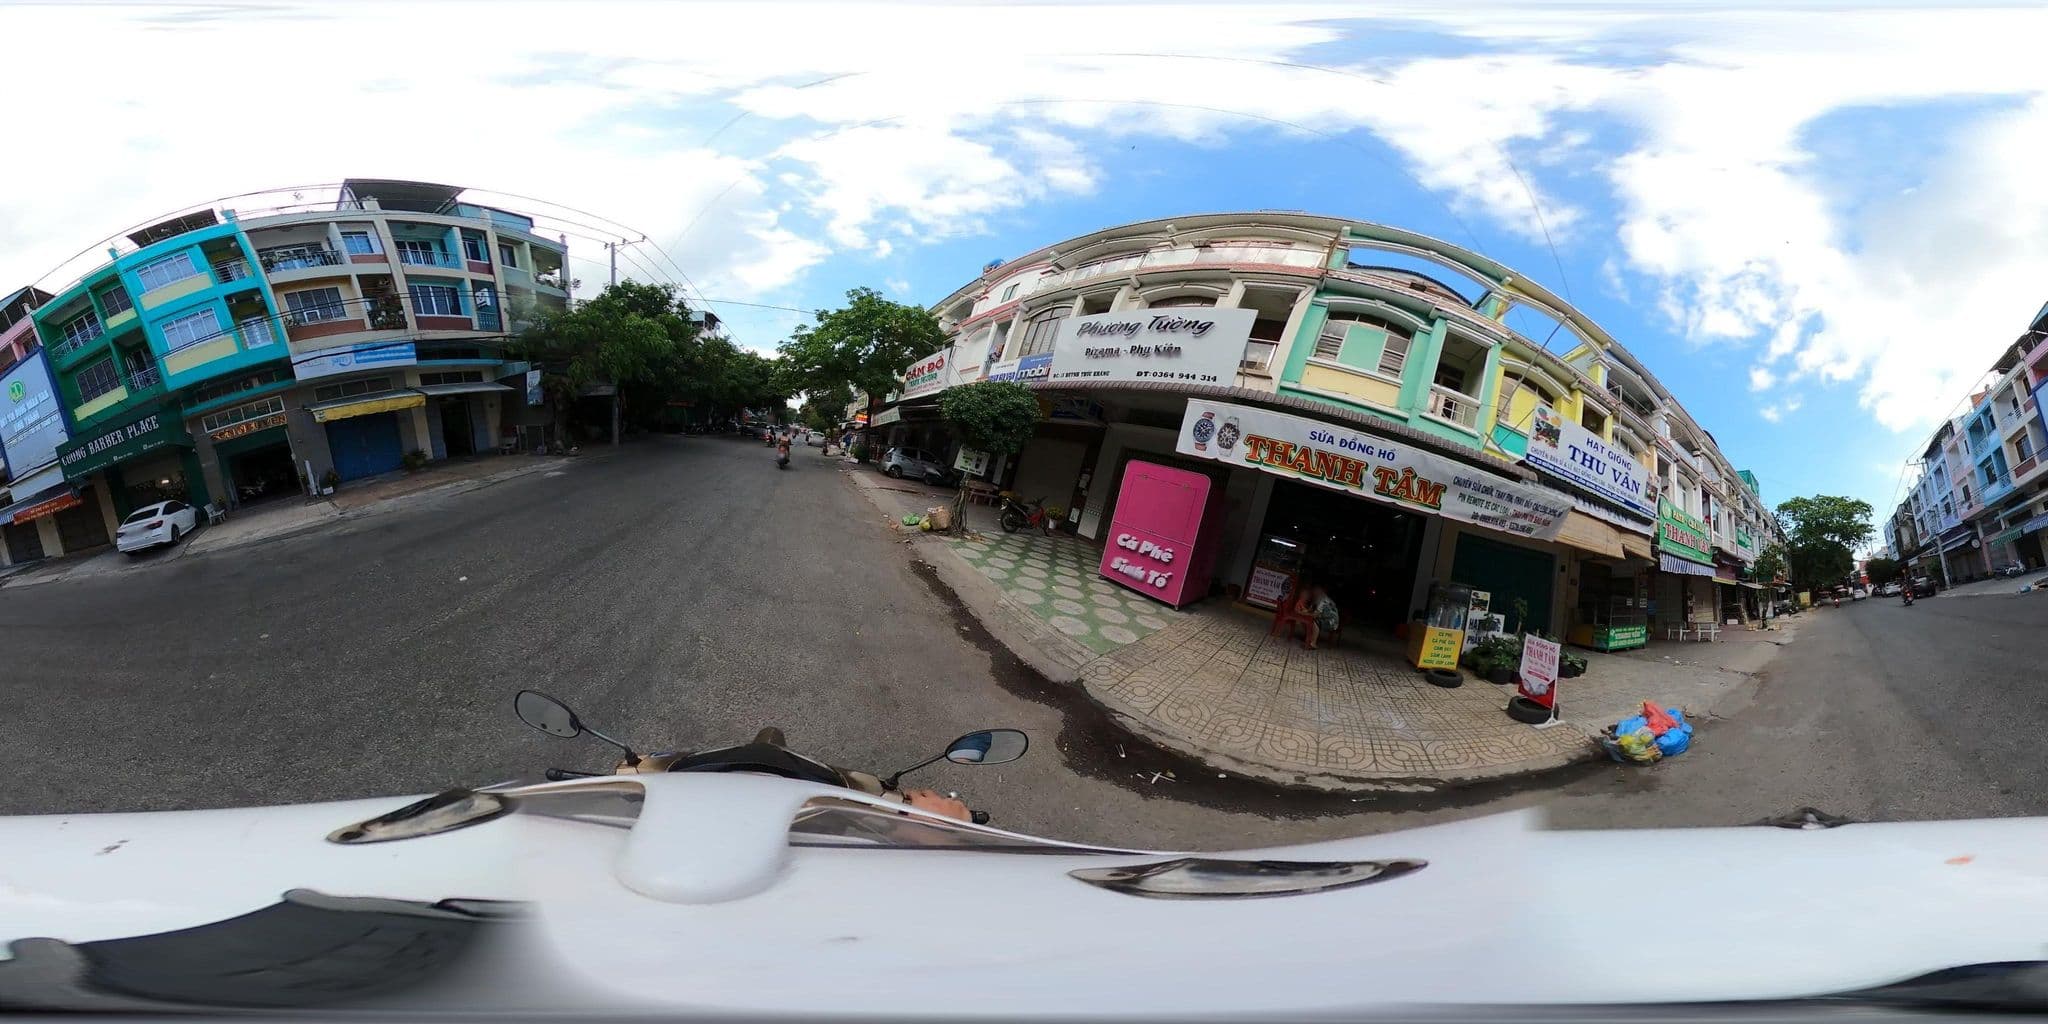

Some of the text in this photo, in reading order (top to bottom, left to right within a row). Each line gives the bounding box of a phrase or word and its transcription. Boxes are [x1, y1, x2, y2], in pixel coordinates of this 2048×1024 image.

[1077, 315, 1214, 339] Phương Tường
[1130, 345, 1150, 357] Phụ
[1200, 374, 1217, 382] 314
[87, 430, 125, 455] BARBER
[126, 415, 160, 439] PLACE
[1309, 429, 1397, 462] SỬA ĐỒNG HỒ
[1244, 433, 1448, 511] THANH TÂM
[1568, 444, 1607, 476] THU
[1611, 467, 1641, 495] VÂN
[1607, 449, 1632, 471] GIỐNG
[1457, 493, 1466, 503] PIN
[1466, 496, 1485, 509] REMOTE
[1117, 533, 1173, 563] Cà Phê
[1663, 521, 1697, 550] THANH
[1110, 556, 1173, 588] Sinh Tố
